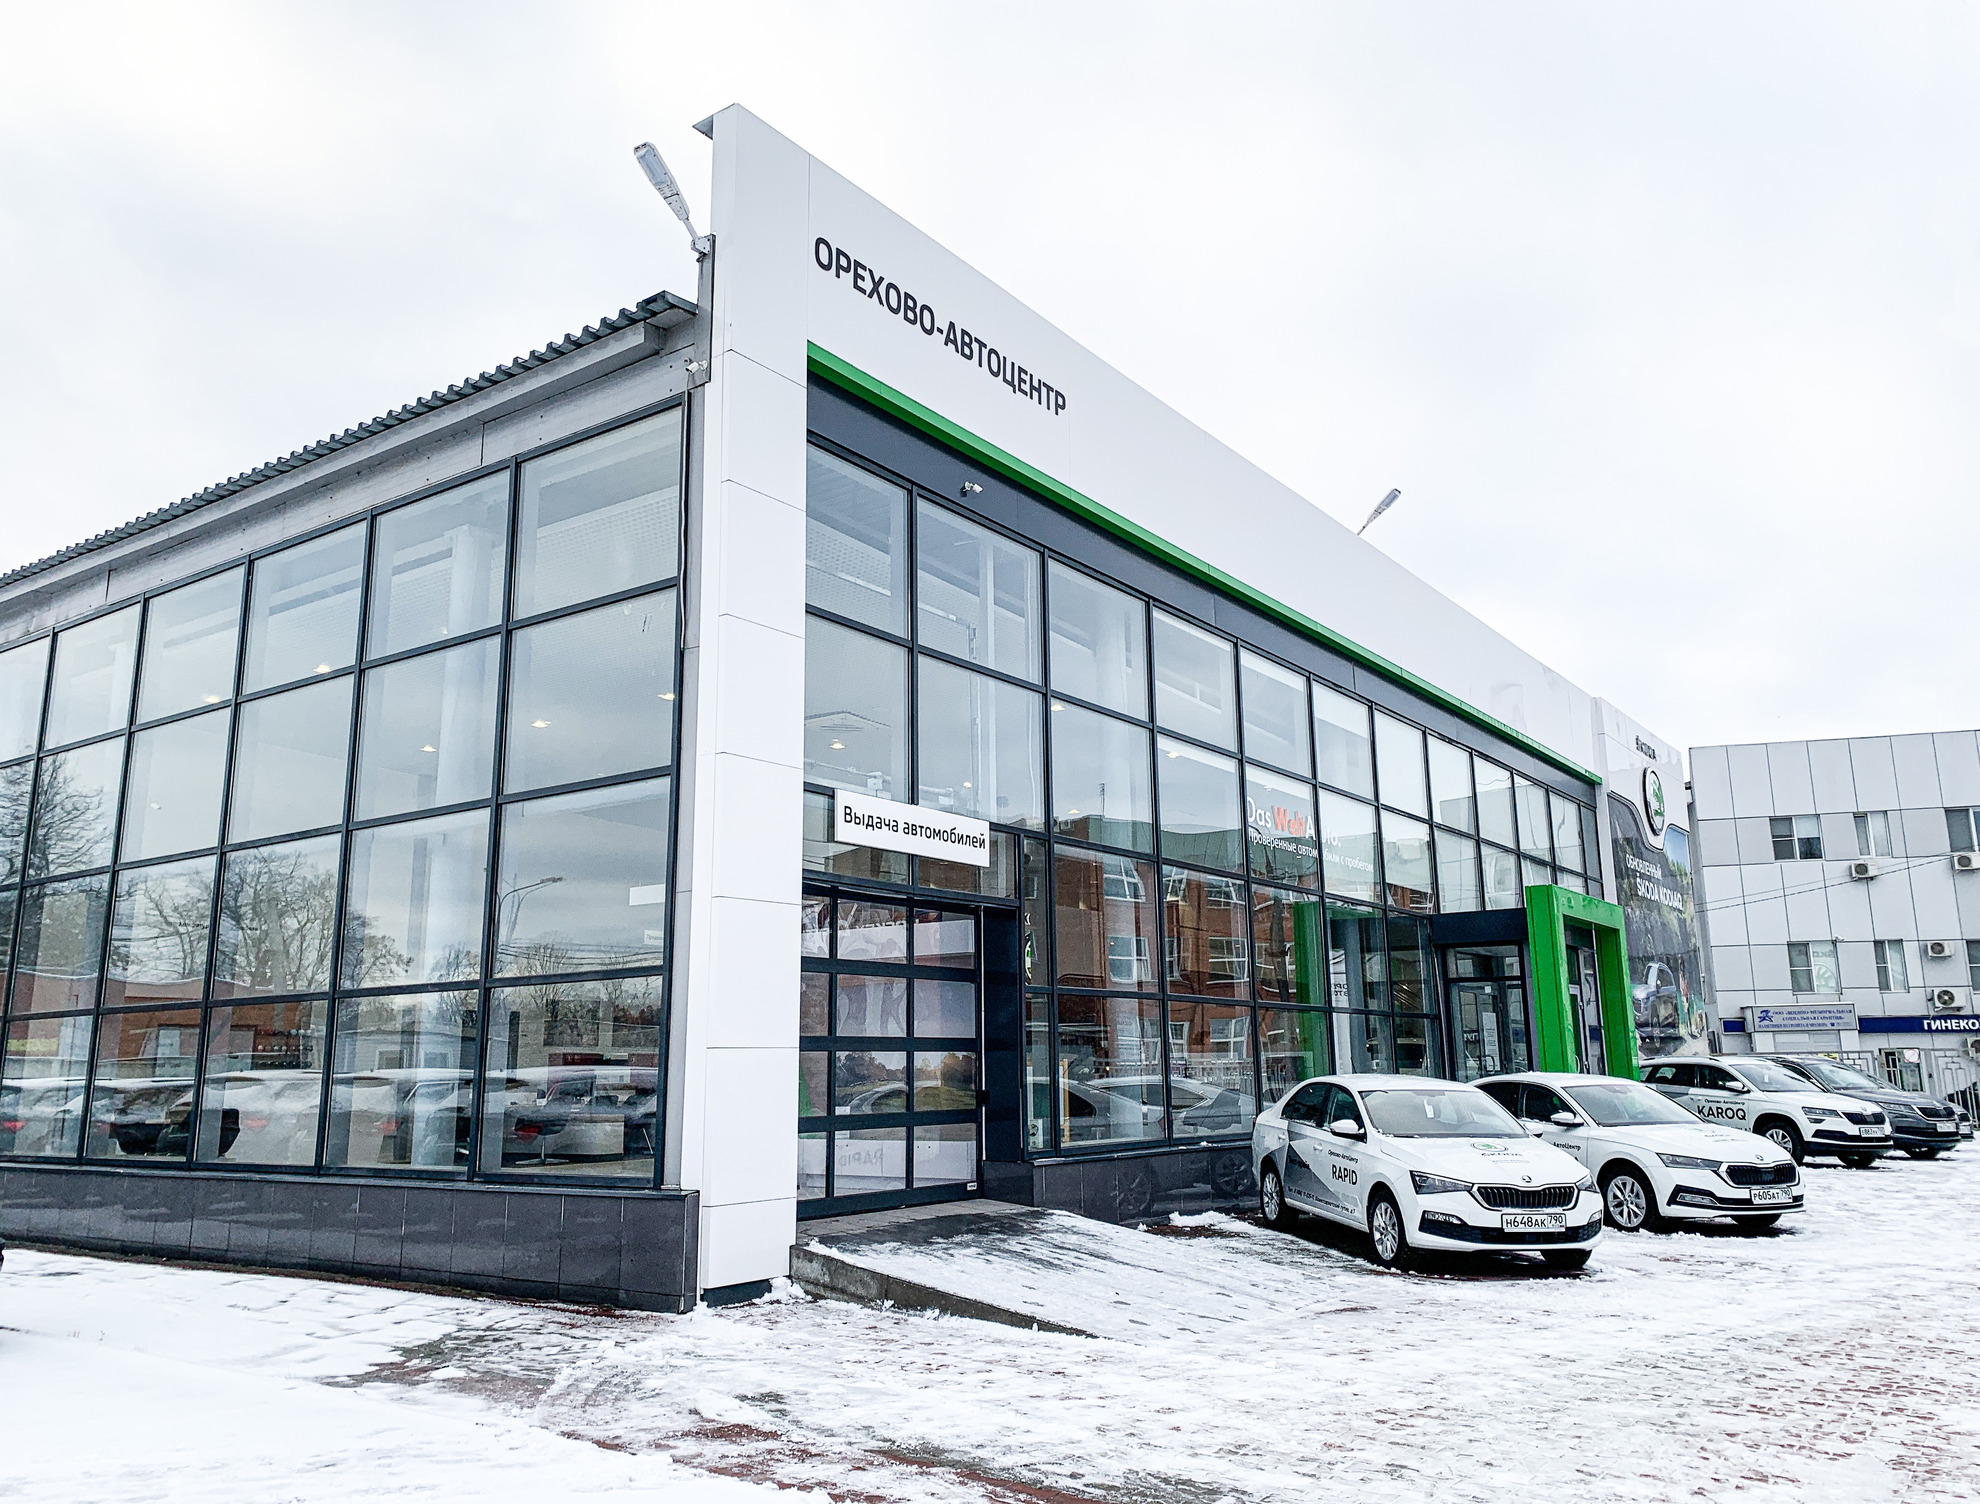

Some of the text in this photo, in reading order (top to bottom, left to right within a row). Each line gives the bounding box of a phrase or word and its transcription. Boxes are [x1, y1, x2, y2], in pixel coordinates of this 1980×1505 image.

[814, 236, 1067, 416] ОРЕХОВО-АВТОЦЕНТР
[1247, 796, 1272, 829] Das
[844, 805, 986, 850] Выдача автомобилей
[1923, 1018, 1980, 1030] ГИНЕКО
[1697, 1105, 1747, 1121] KAROQ
[1332, 1164, 1358, 1186] RAPID
[1505, 1215, 1564, 1228] Н648АК 790
